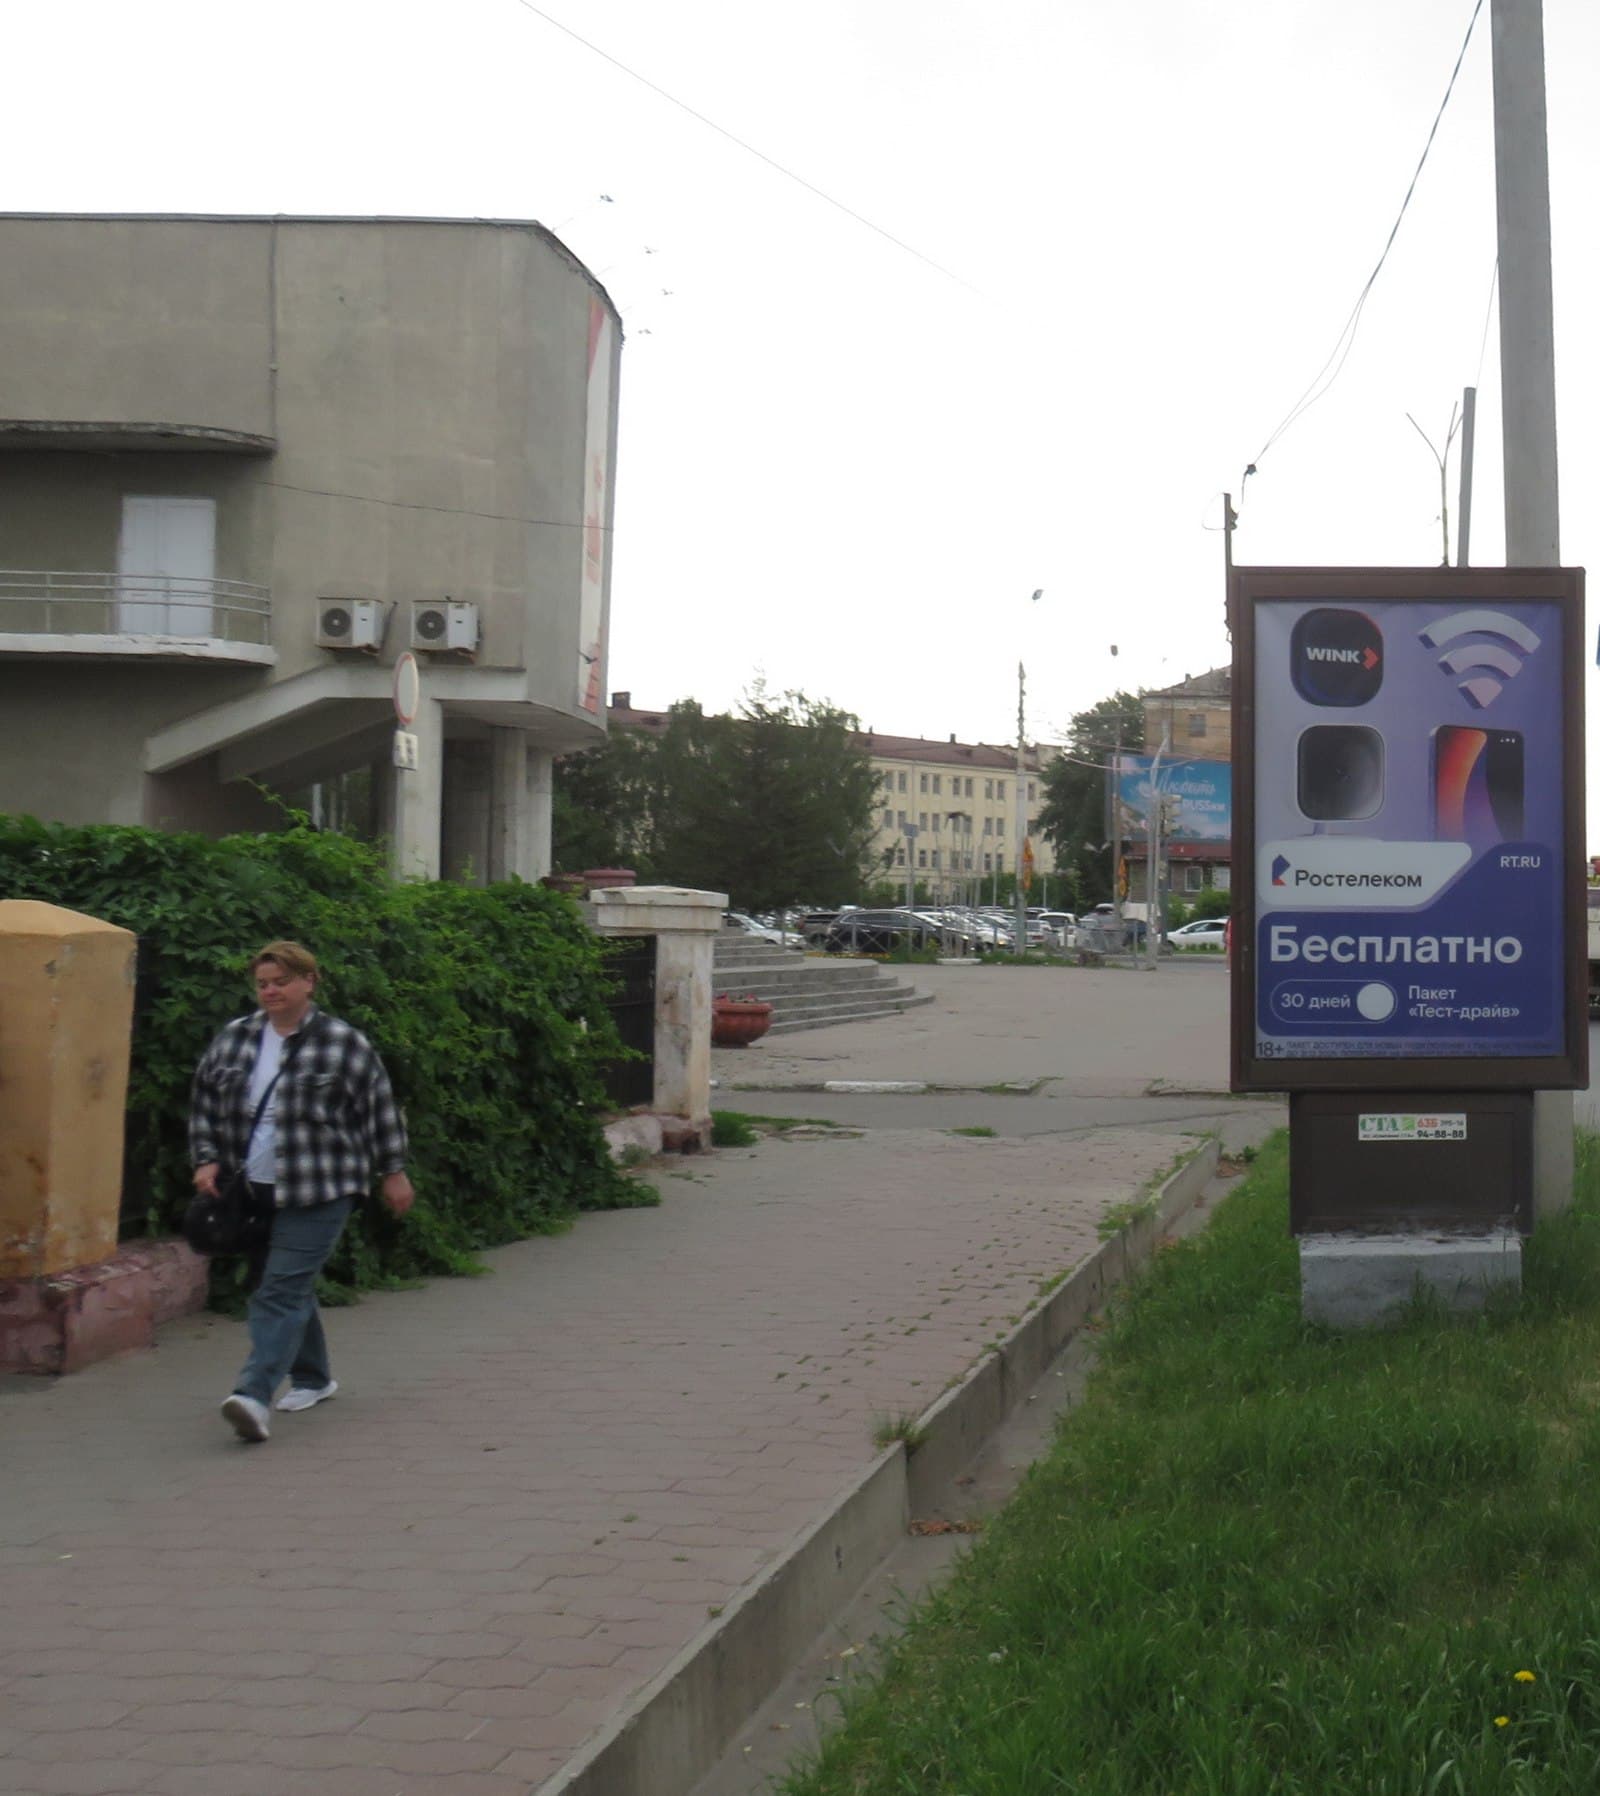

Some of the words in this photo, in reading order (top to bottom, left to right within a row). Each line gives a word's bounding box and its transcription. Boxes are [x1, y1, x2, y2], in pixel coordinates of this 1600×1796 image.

[1306, 647, 1360, 665] WINK
[1500, 855, 1541, 868] RT.RU
[1295, 869, 1422, 888] Ростелеком
[1270, 925, 1523, 963] Бесплатно
[1408, 985, 1456, 1000] Пакет
[1280, 993, 1304, 1009] 30
[1308, 994, 1351, 1010] дней
[1408, 1003, 1520, 1020] «Тест-драйв»
[1256, 1043, 1284, 1058] 18+
